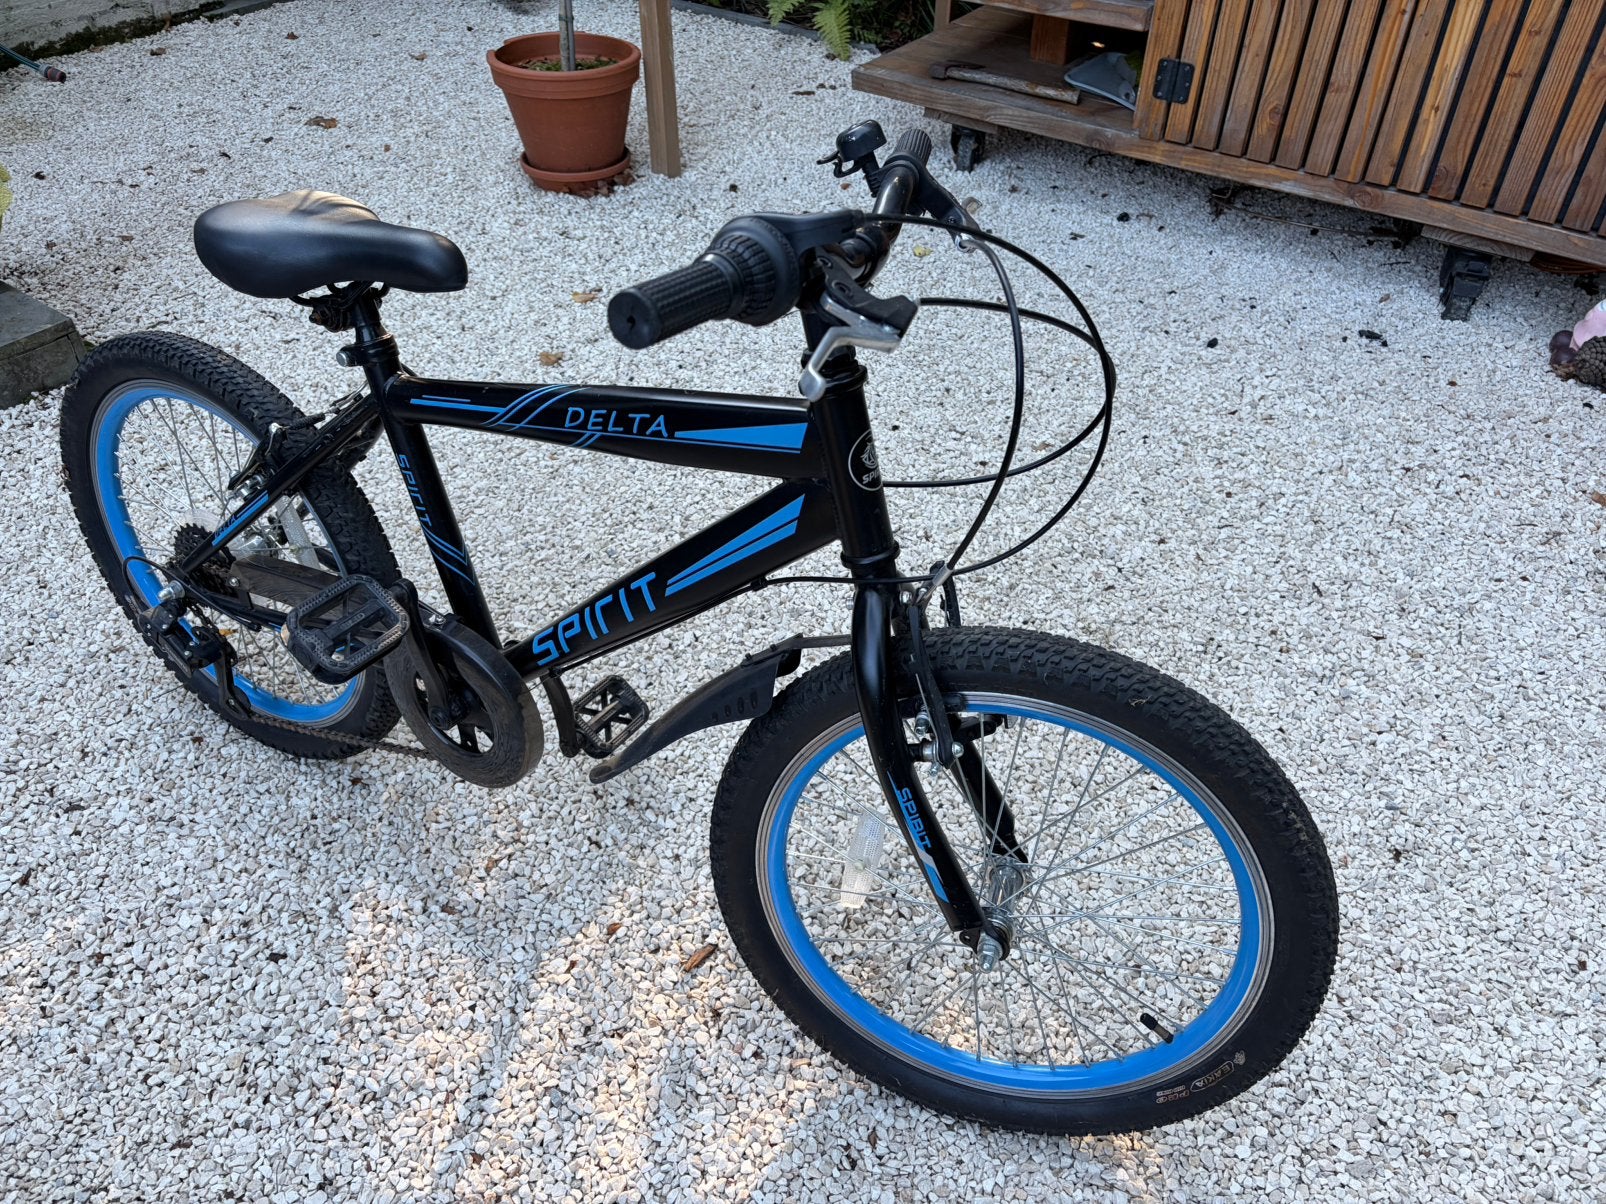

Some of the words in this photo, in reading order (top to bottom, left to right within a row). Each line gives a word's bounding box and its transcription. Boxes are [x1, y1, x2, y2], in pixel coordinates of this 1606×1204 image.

[564, 406, 669, 438] DELTA
[396, 453, 432, 527] SPIRIT
[862, 471, 881, 485] SPI
[532, 572, 657, 666] SPIRIT
[899, 786, 932, 849] SPIRIT
